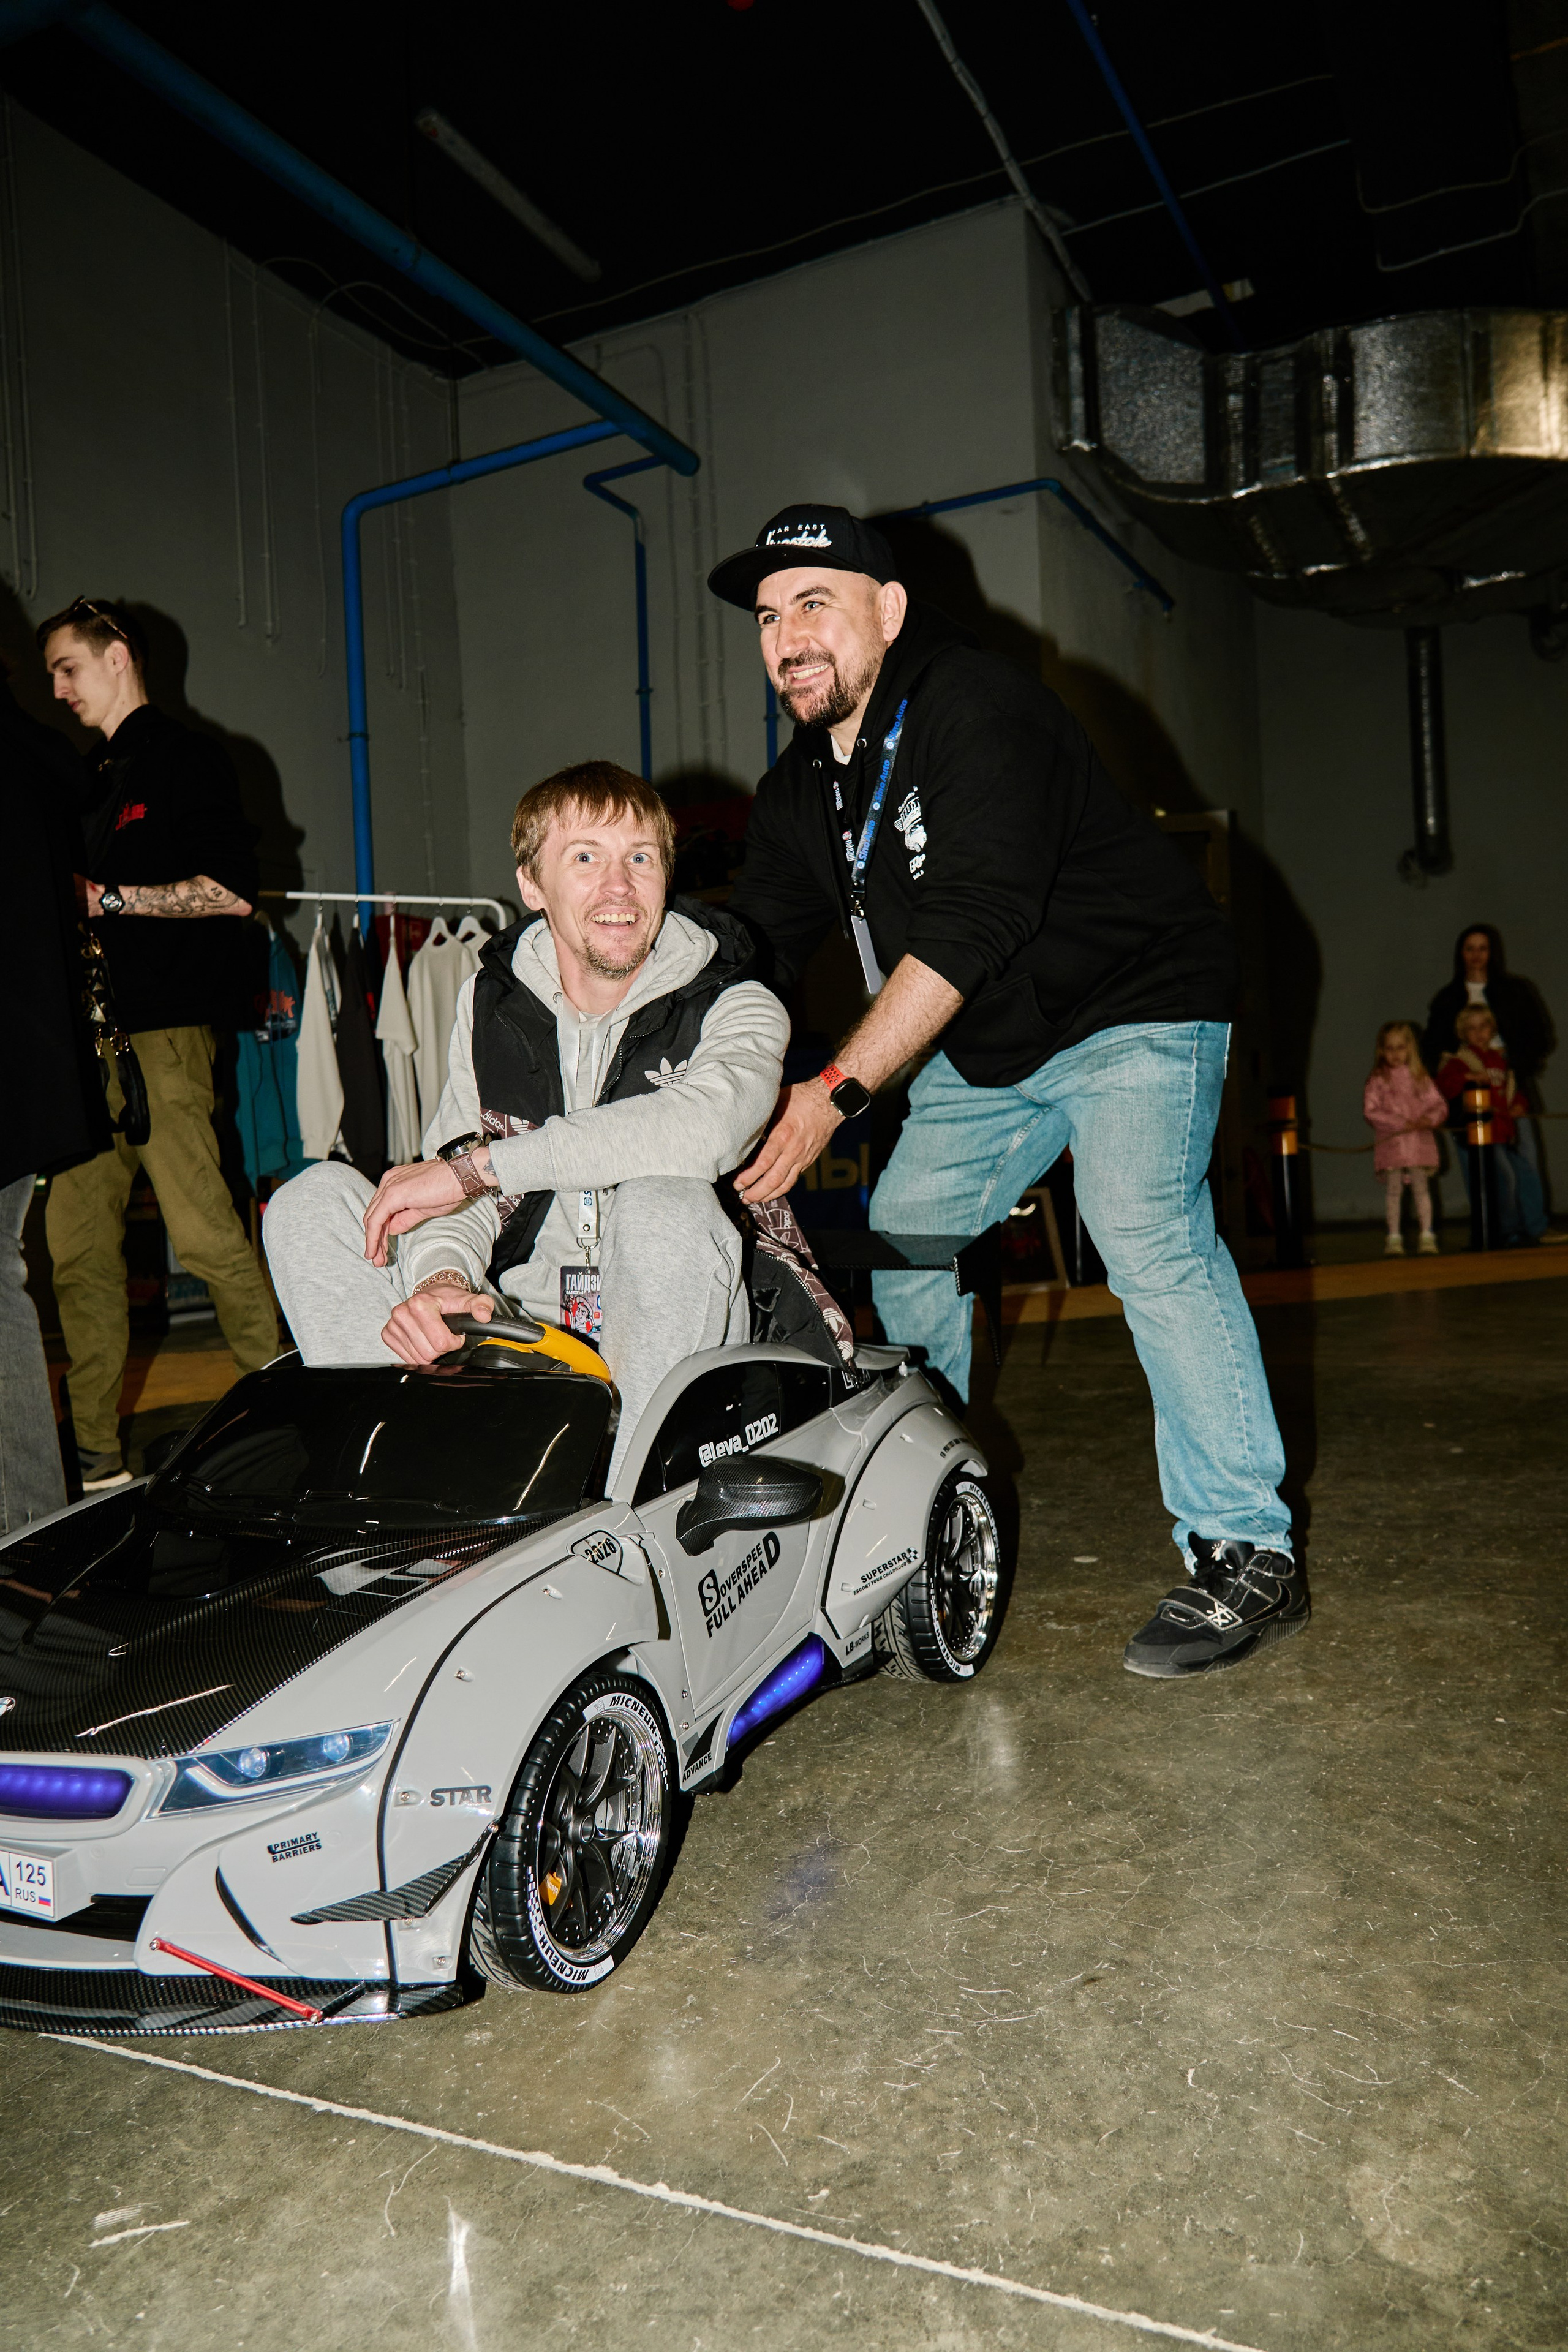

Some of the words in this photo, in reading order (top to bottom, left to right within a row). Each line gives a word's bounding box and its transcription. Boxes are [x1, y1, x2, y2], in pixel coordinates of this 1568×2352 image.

[772, 526, 790, 536] FAR
[698, 1413, 778, 1468] @leva_0202
[584, 1537, 617, 1564] 2026
[853, 1582, 871, 1596] ESCORT
[870, 1575, 883, 1585] YOUR
[883, 1561, 907, 1578] CHILDHOOD
[861, 1551, 908, 1583] SUPERSTAR
[706, 1596, 737, 1639] FULL
[682, 1752, 712, 1783] ADVANCE
[430, 1785, 492, 1807] STAR
[271, 1842, 322, 1863] BARRIERS
[273, 1831, 317, 1850] PRIMARY
[15, 1861, 47, 1886] 125
[15, 1887, 36, 1902] RUS
